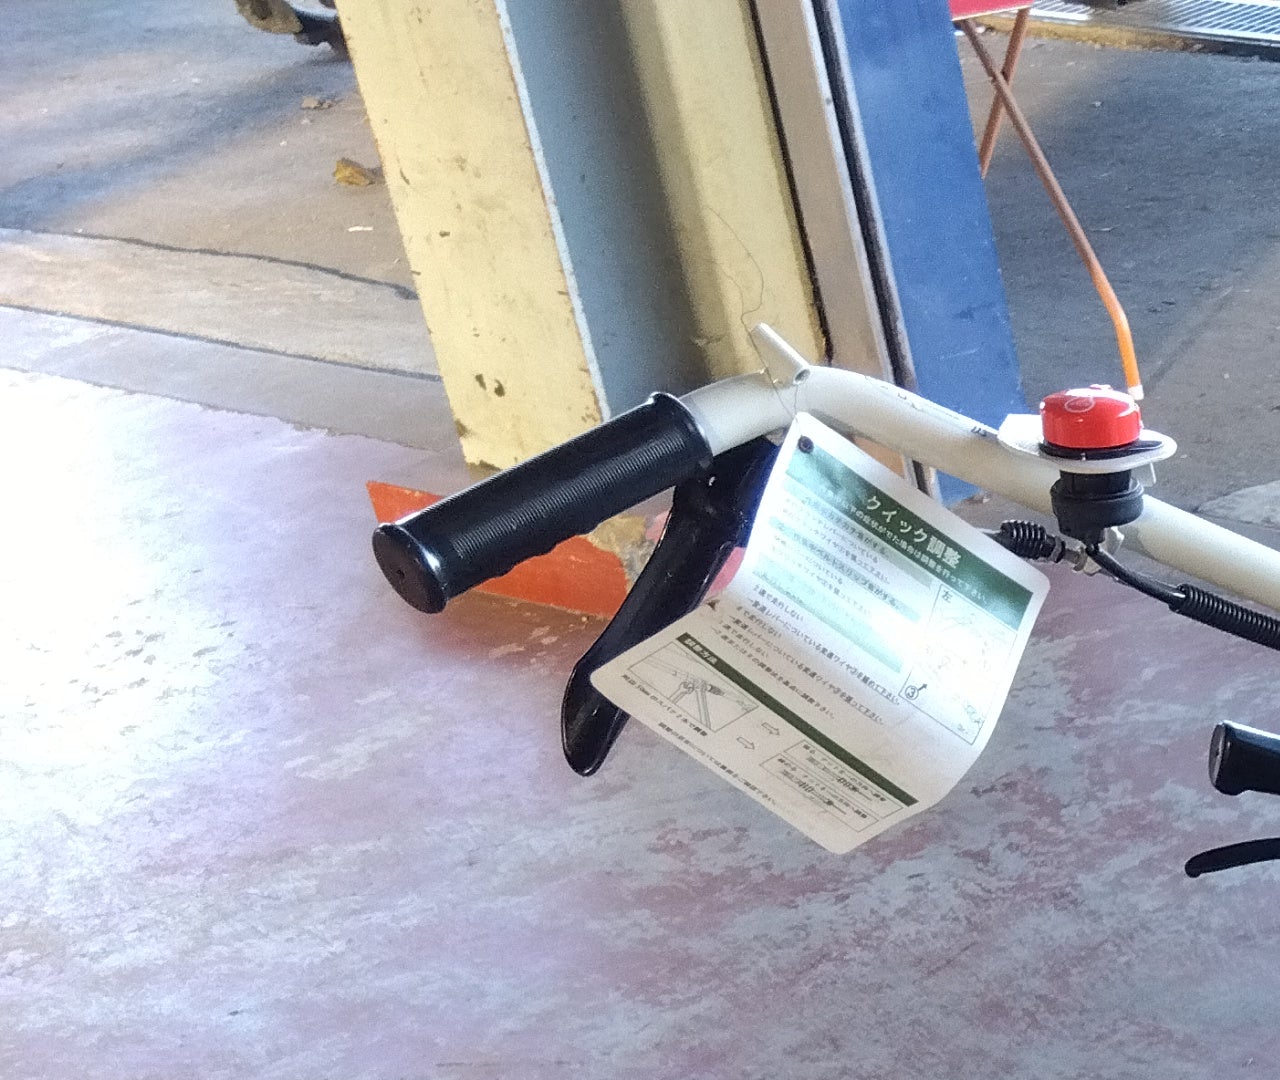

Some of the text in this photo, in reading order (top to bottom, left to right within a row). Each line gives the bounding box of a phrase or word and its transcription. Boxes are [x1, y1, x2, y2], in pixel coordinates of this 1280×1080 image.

[866, 496, 962, 570] クイック調整
[942, 590, 953, 604] 左
